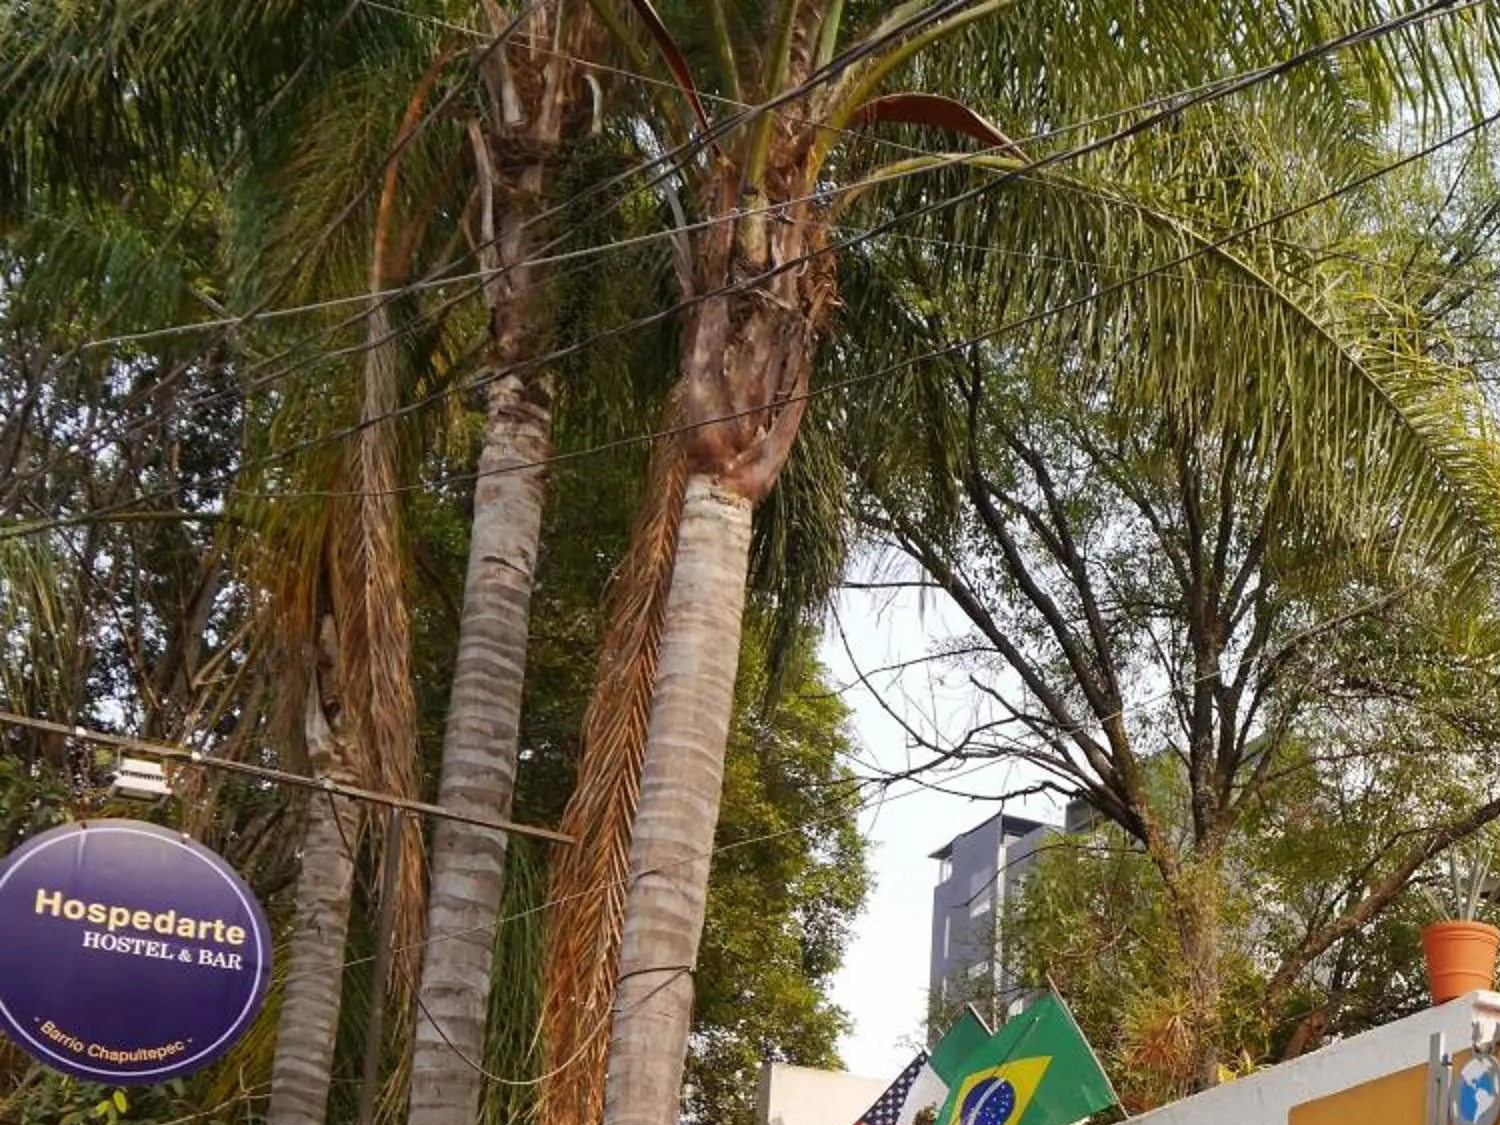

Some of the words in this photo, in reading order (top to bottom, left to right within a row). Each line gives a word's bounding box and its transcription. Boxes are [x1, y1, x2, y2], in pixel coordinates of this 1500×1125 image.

[35, 888, 246, 945] Hospedarte
[83, 931, 174, 960] HOSTEL
[178, 949, 192, 963] &
[198, 950, 242, 970] BAR
[40, 1020, 84, 1053] Barrio
[88, 1041, 185, 1065] Chapultepec
